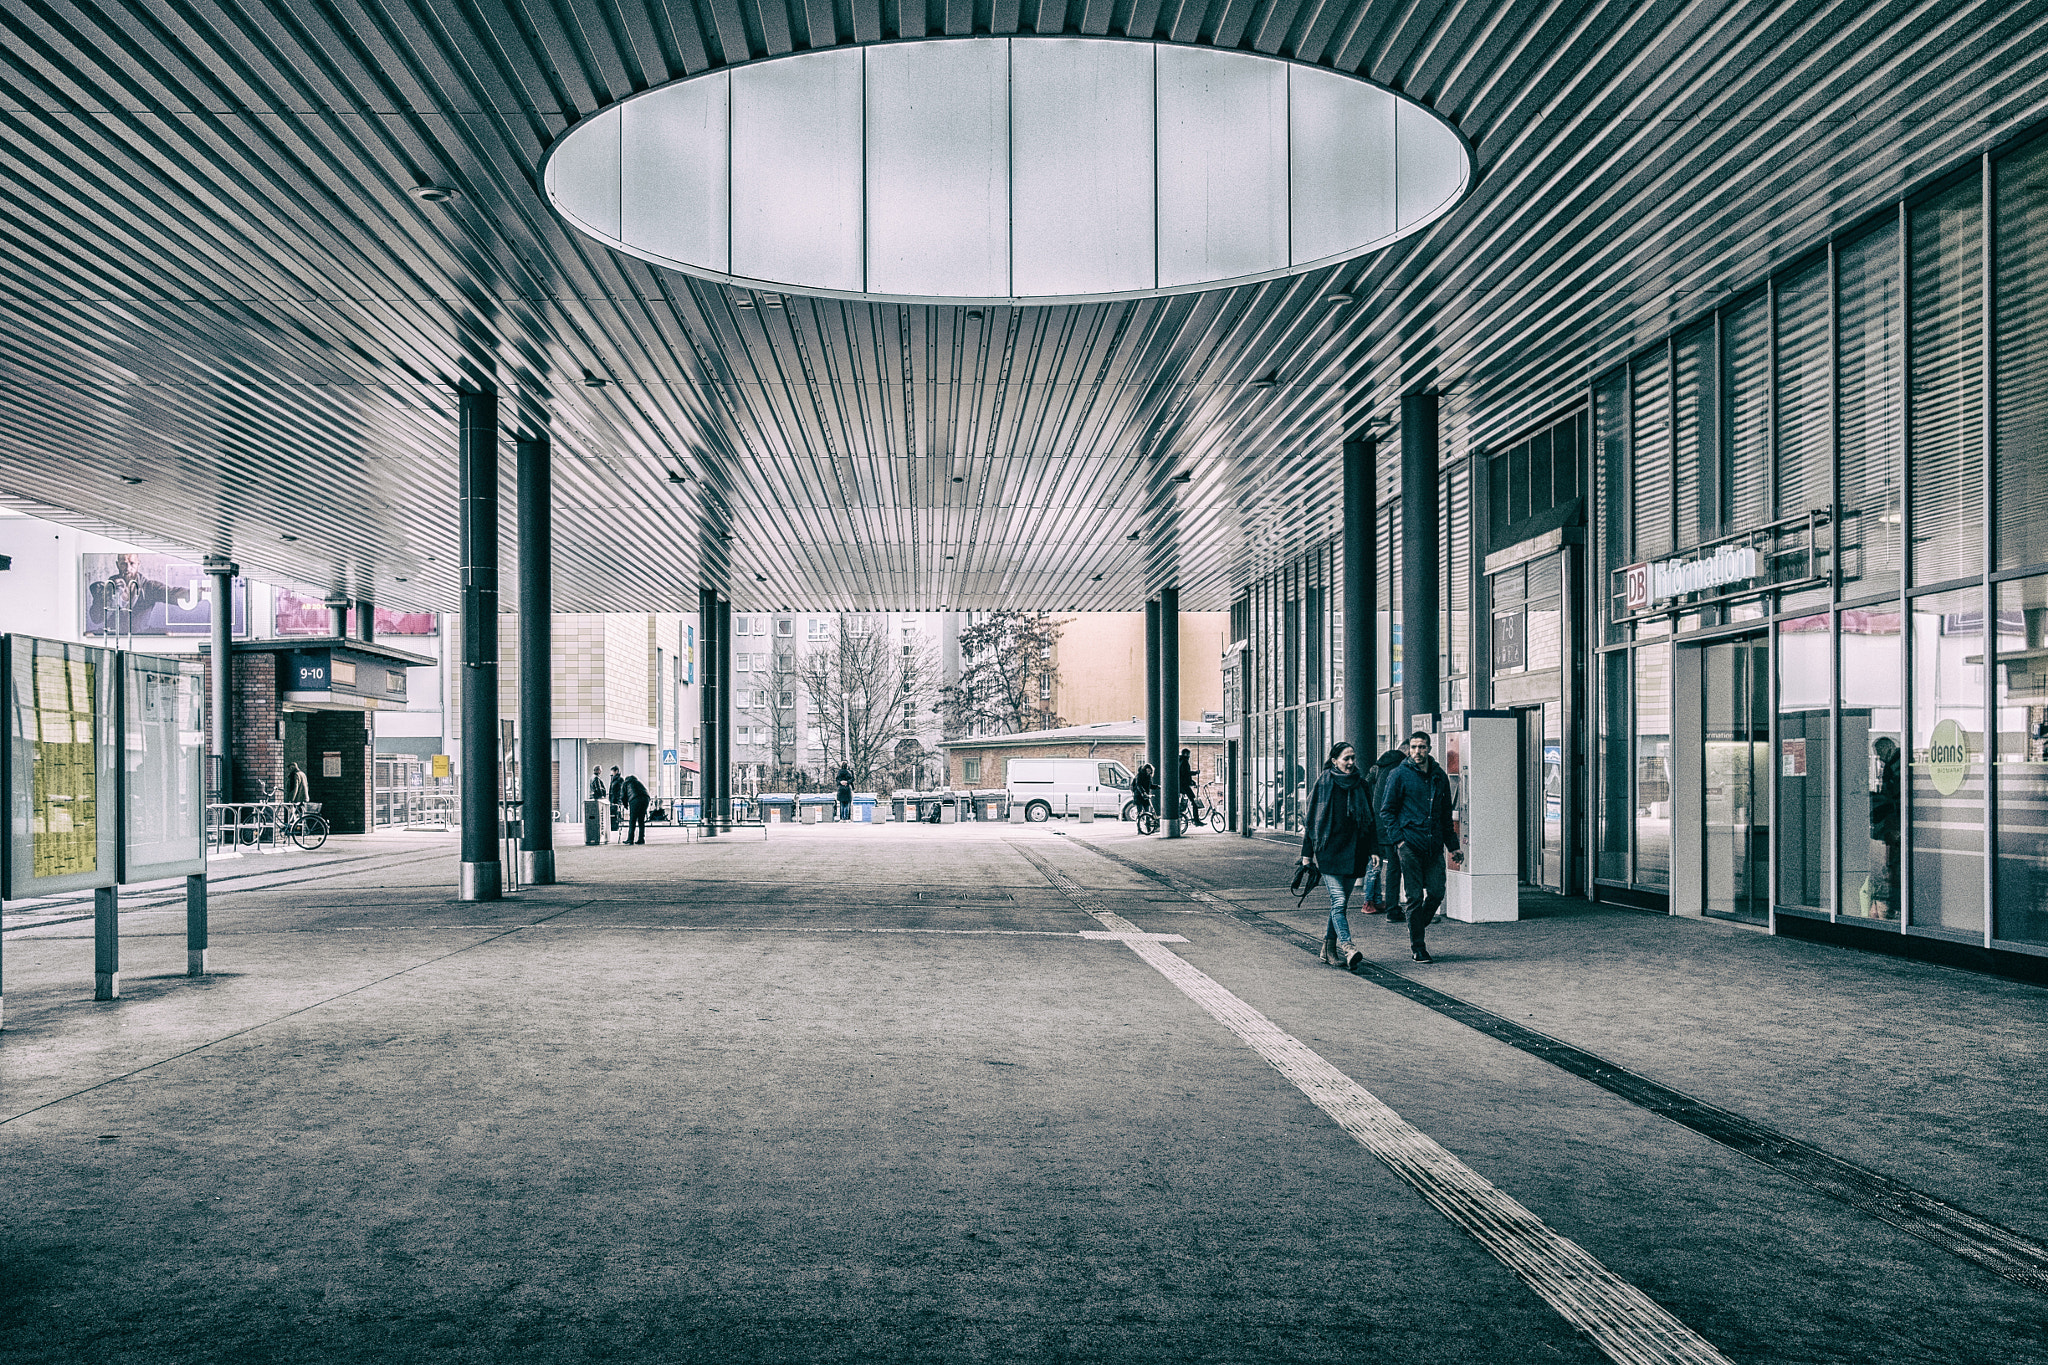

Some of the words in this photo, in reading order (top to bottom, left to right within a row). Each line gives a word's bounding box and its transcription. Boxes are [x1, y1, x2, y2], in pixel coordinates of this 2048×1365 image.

[1628, 570, 1646, 604] DB
[1654, 544, 1757, 598] Information
[1501, 616, 1514, 641] 7-8
[300, 668, 324, 679] 9-10
